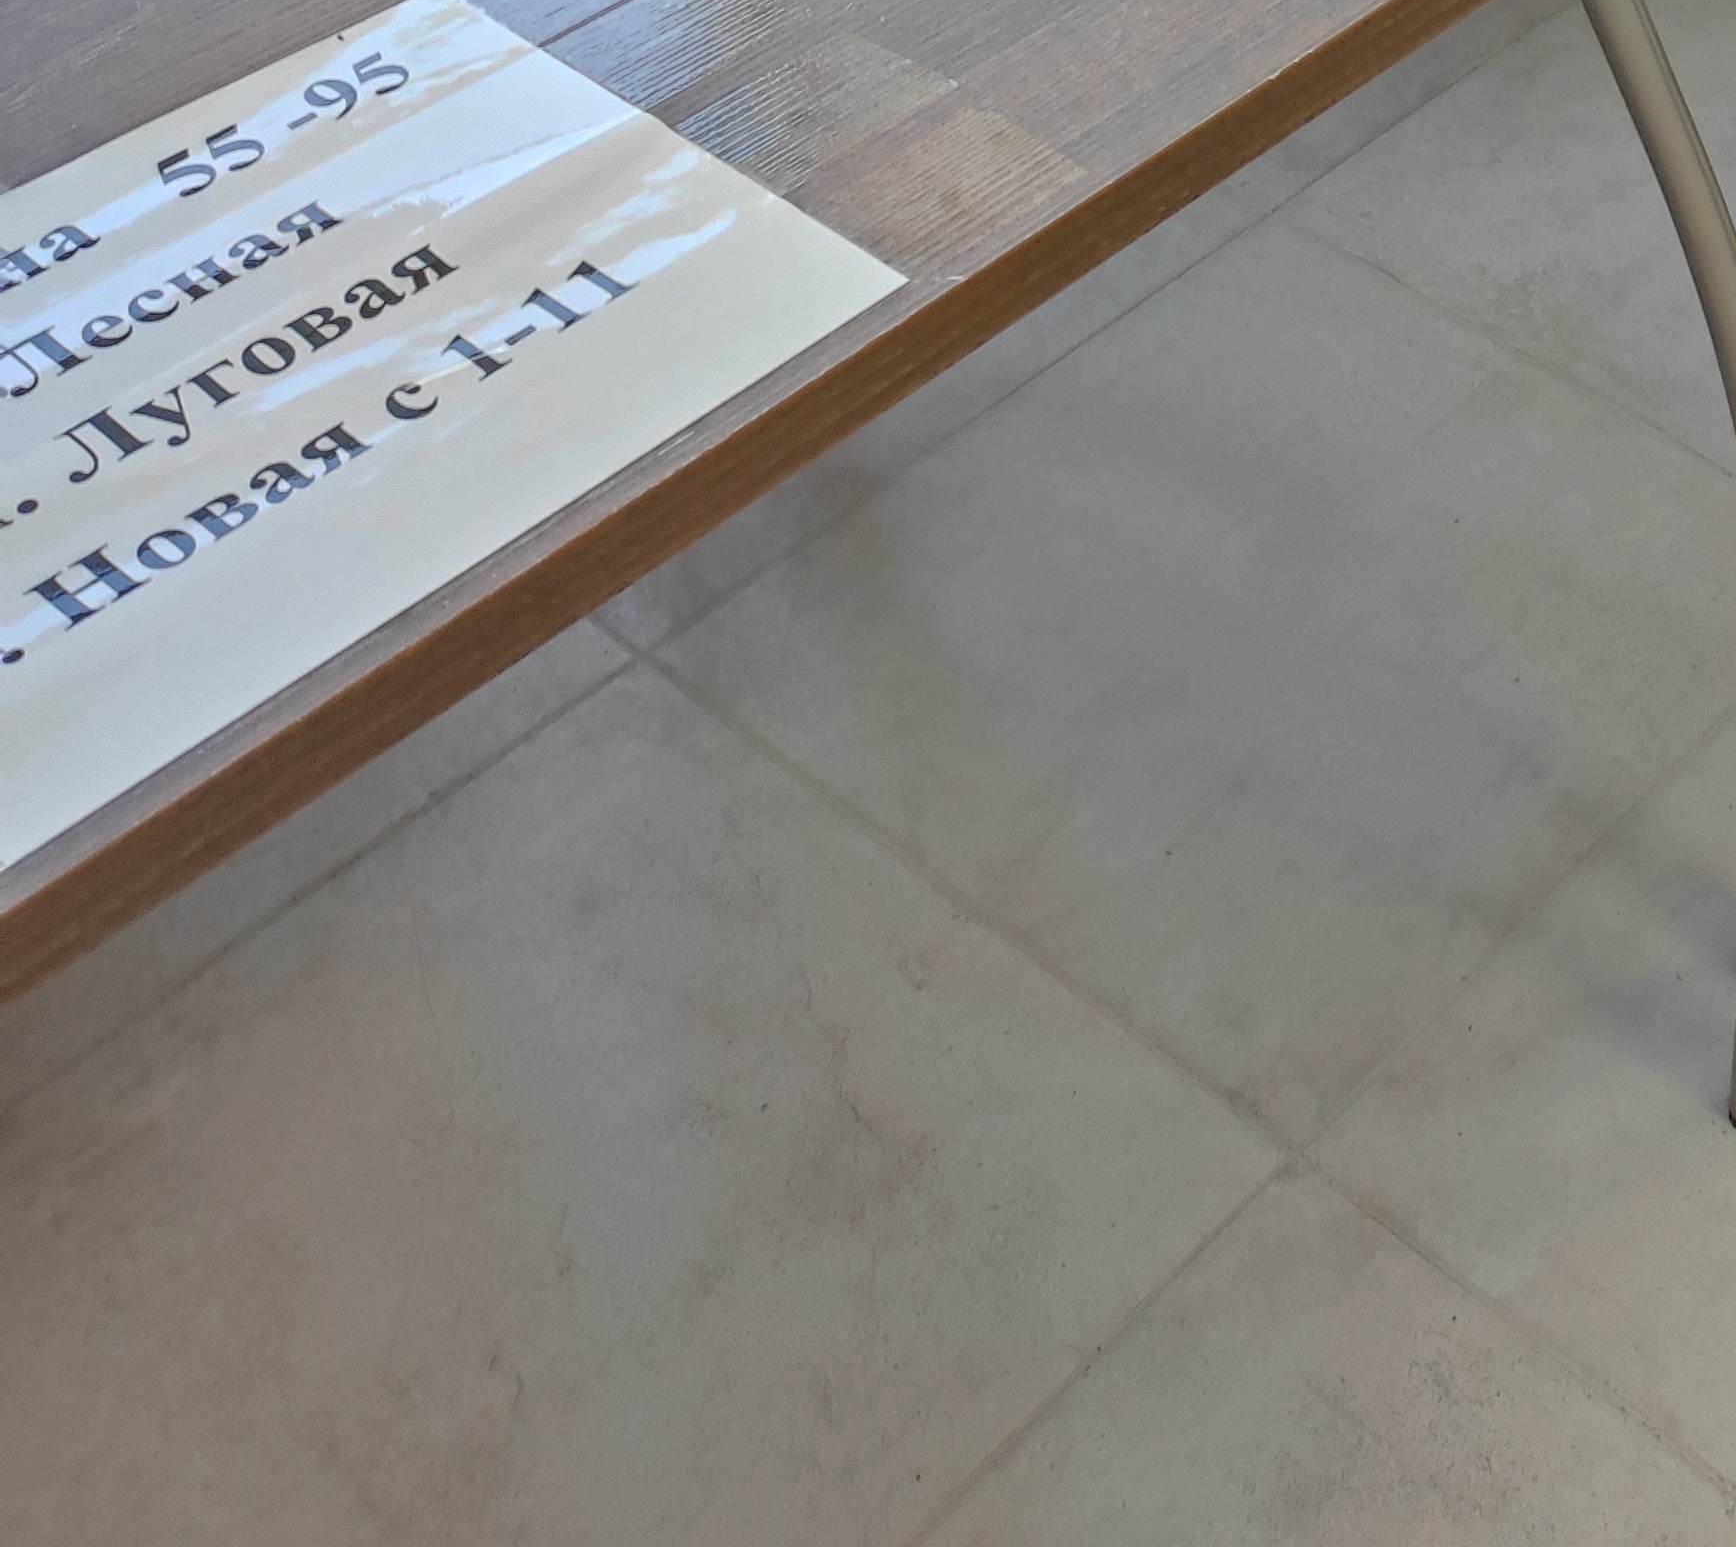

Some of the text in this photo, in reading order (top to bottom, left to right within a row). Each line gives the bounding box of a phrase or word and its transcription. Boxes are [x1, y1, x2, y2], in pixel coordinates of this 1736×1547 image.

[0, 199, 344, 397] Лесная
[54, 243, 460, 484] Луговая
[22, 259, 640, 632] Новая с 1-11
